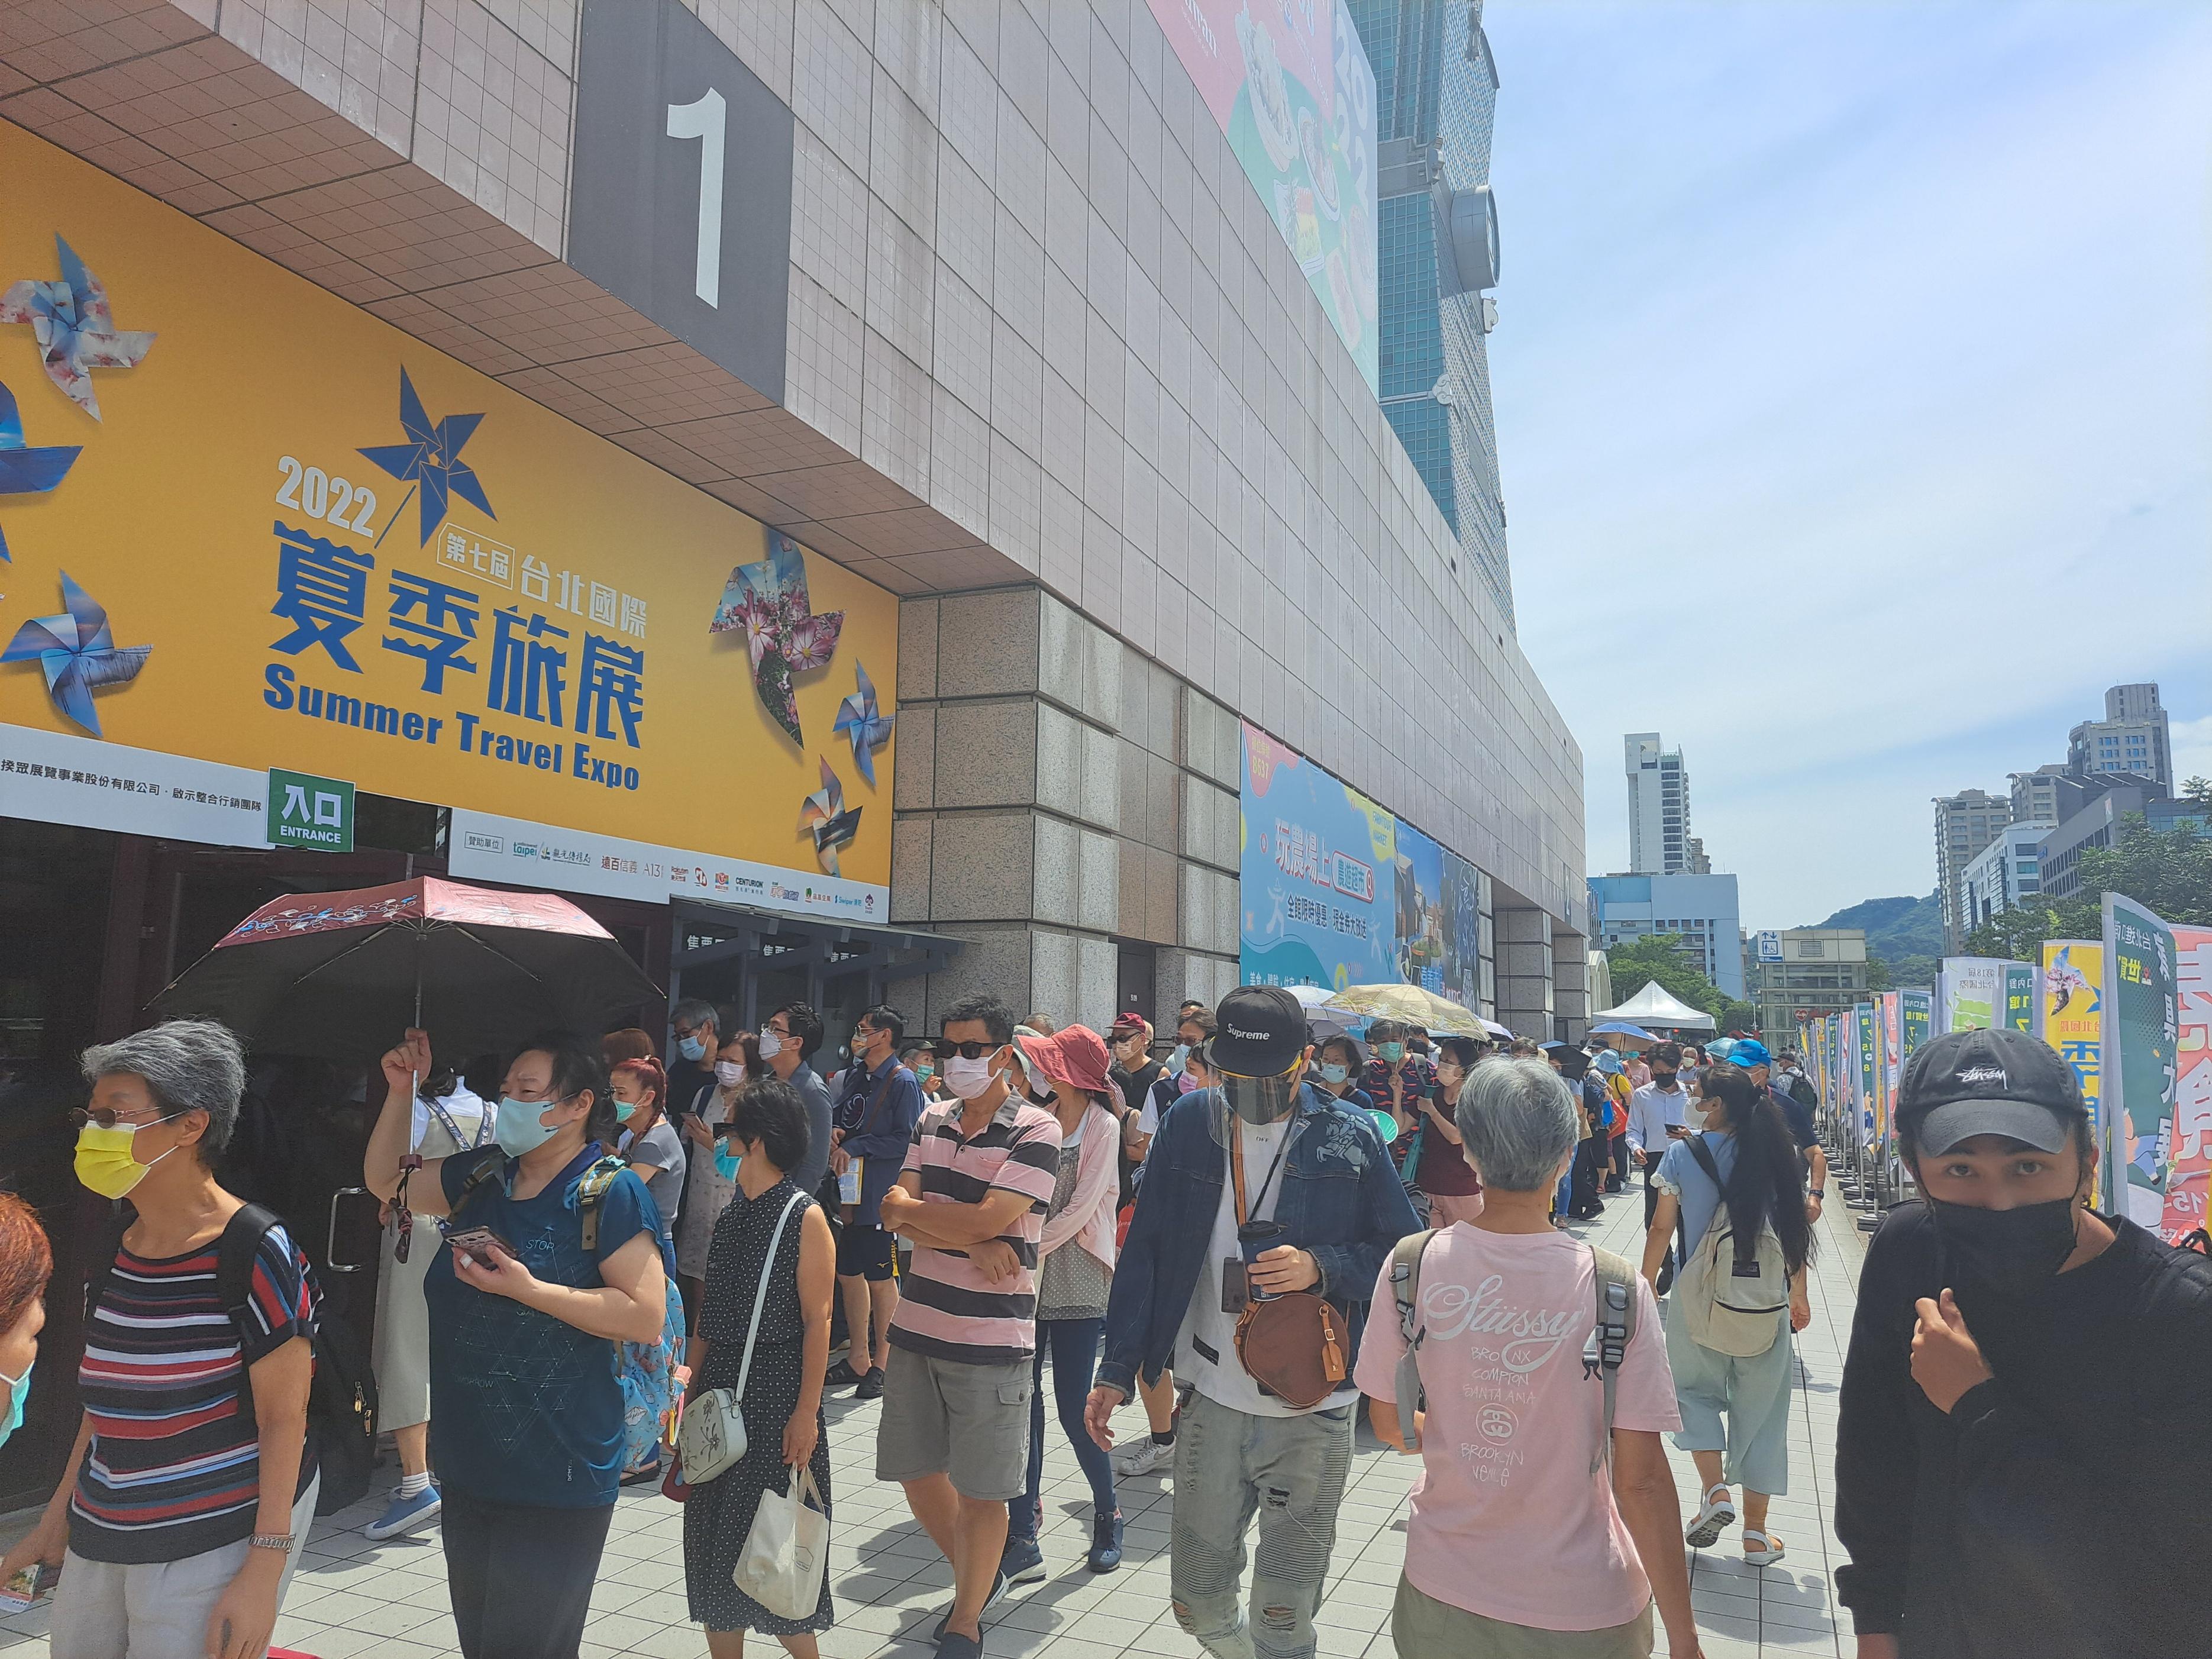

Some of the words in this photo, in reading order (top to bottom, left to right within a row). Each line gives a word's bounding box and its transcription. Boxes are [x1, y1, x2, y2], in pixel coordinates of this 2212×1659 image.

[667, 87, 726, 310] 1
[276, 456, 376, 538] 2022
[520, 554, 647, 639] 台北國際
[268, 520, 645, 749] 夏季旅展
[263, 663, 443, 744] Summer
[454, 712, 563, 773] Travel
[573, 743, 640, 790] Expo
[281, 784, 341, 828] 入口
[280, 825, 341, 844] ENTRANCE
[601, 856, 637, 874] 遠百信義
[643, 863, 660, 877] A13
[735, 877, 763, 888] CENTURION
[687, 935, 725, 950] 售票
[1226, 1023, 1270, 1040] Supreme
[1472, 1367, 1529, 1386] COMPTON
[1462, 1384, 1503, 1402] SANTA
[1504, 1390, 1536, 1406] ANA
